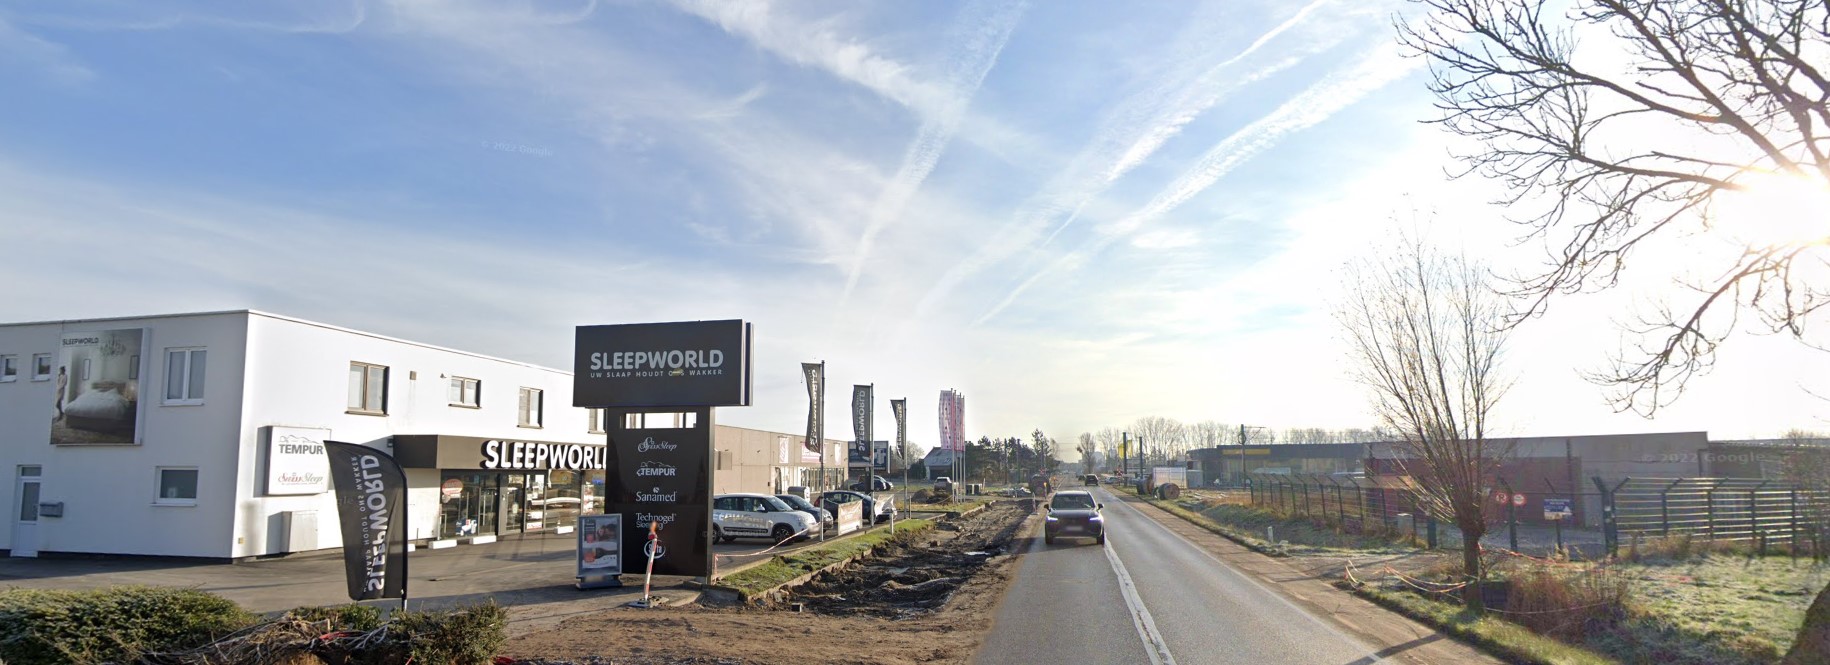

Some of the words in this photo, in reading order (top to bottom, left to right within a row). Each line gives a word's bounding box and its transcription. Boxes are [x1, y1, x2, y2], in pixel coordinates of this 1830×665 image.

[590, 350, 724, 370] SLEEPWORLD
[278, 444, 324, 455] TEMPUR
[485, 439, 608, 469] SLEEPWORL
[640, 468, 676, 476] TEMPUR
[636, 491, 676, 502] Sanamed
[636, 513, 675, 524] Technogel
